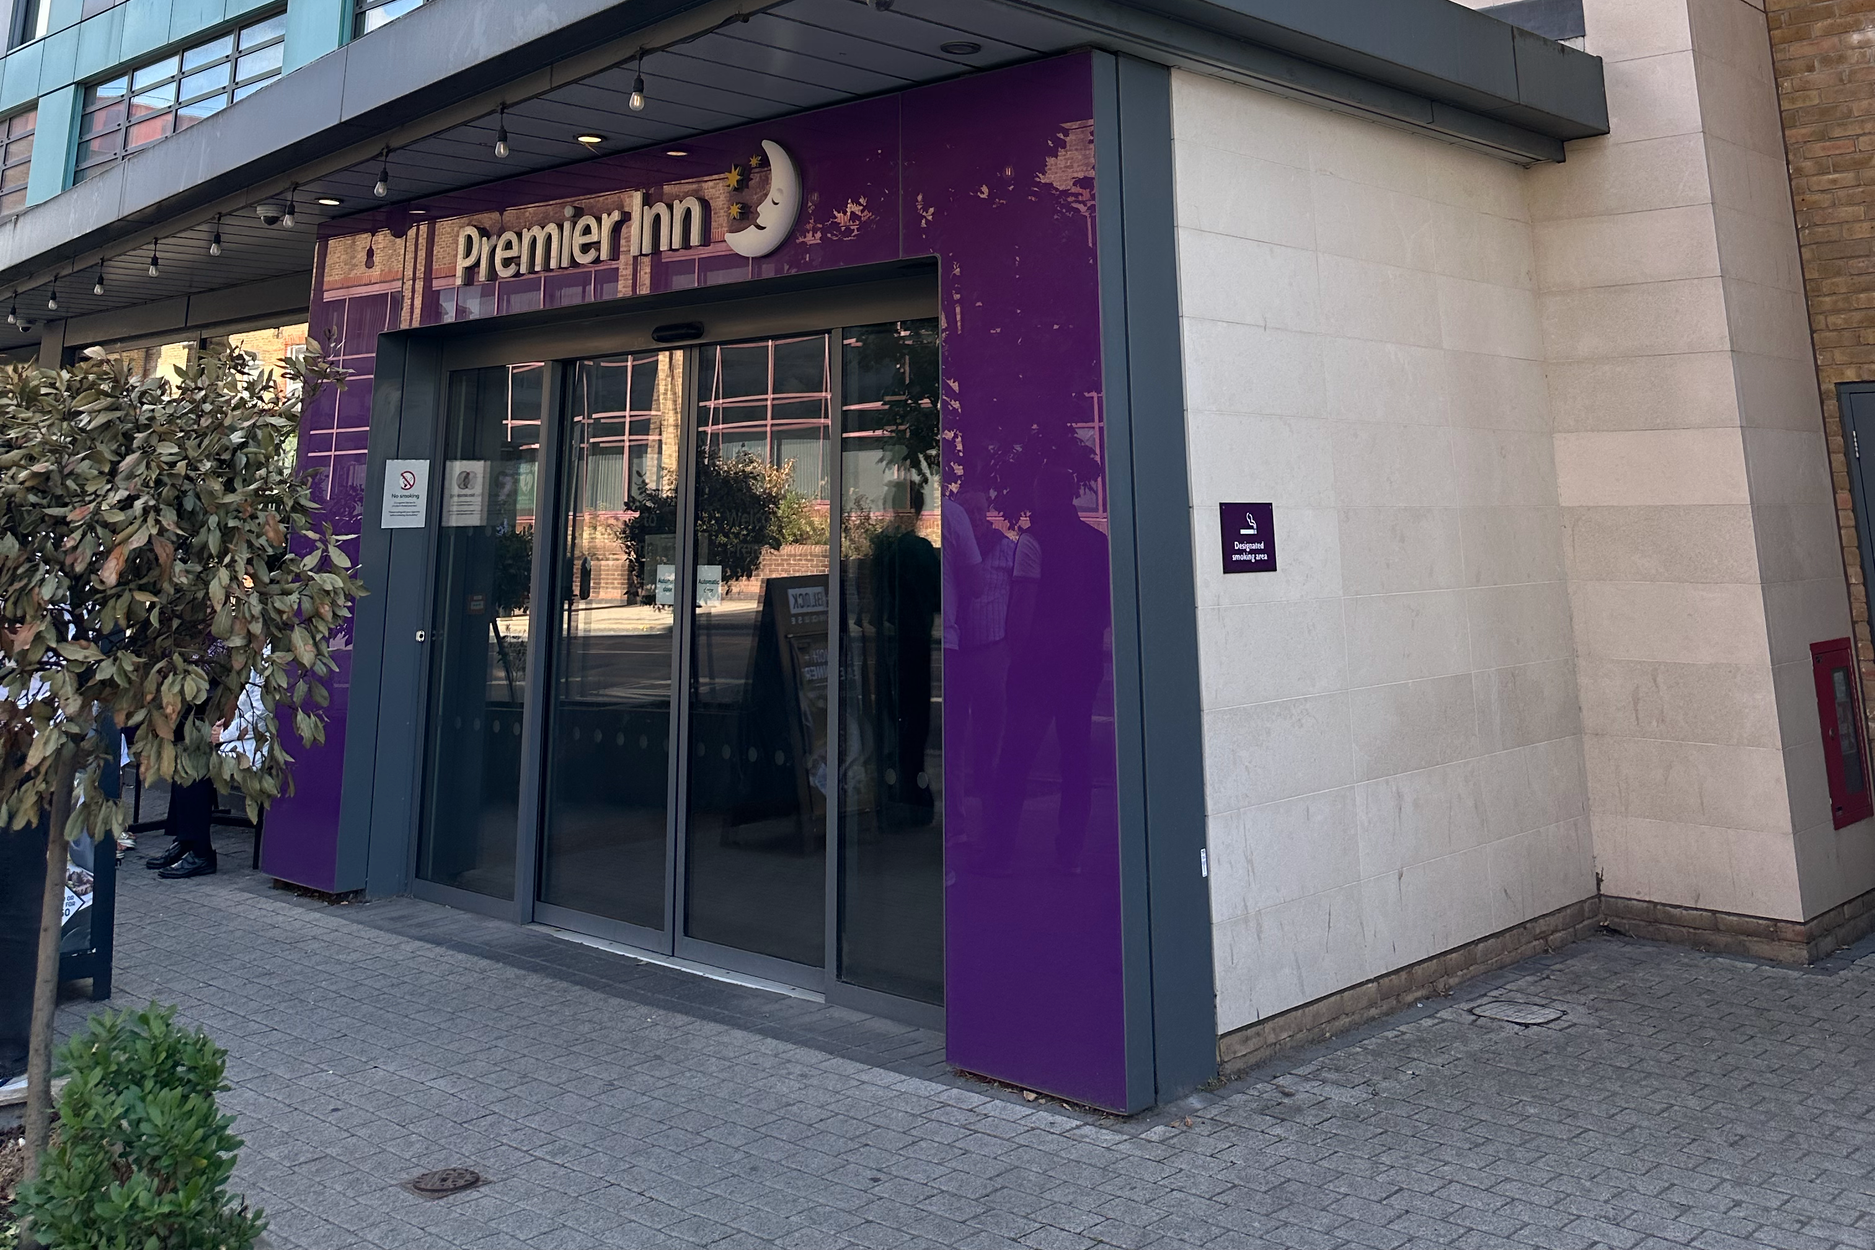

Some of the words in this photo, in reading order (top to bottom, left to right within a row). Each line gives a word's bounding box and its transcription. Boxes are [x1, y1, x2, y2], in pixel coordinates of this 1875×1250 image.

[455, 205, 625, 286] Premier
[631, 188, 706, 257] Inn
[1234, 542, 1264, 552] Designated
[1232, 552, 1256, 562] smoking
